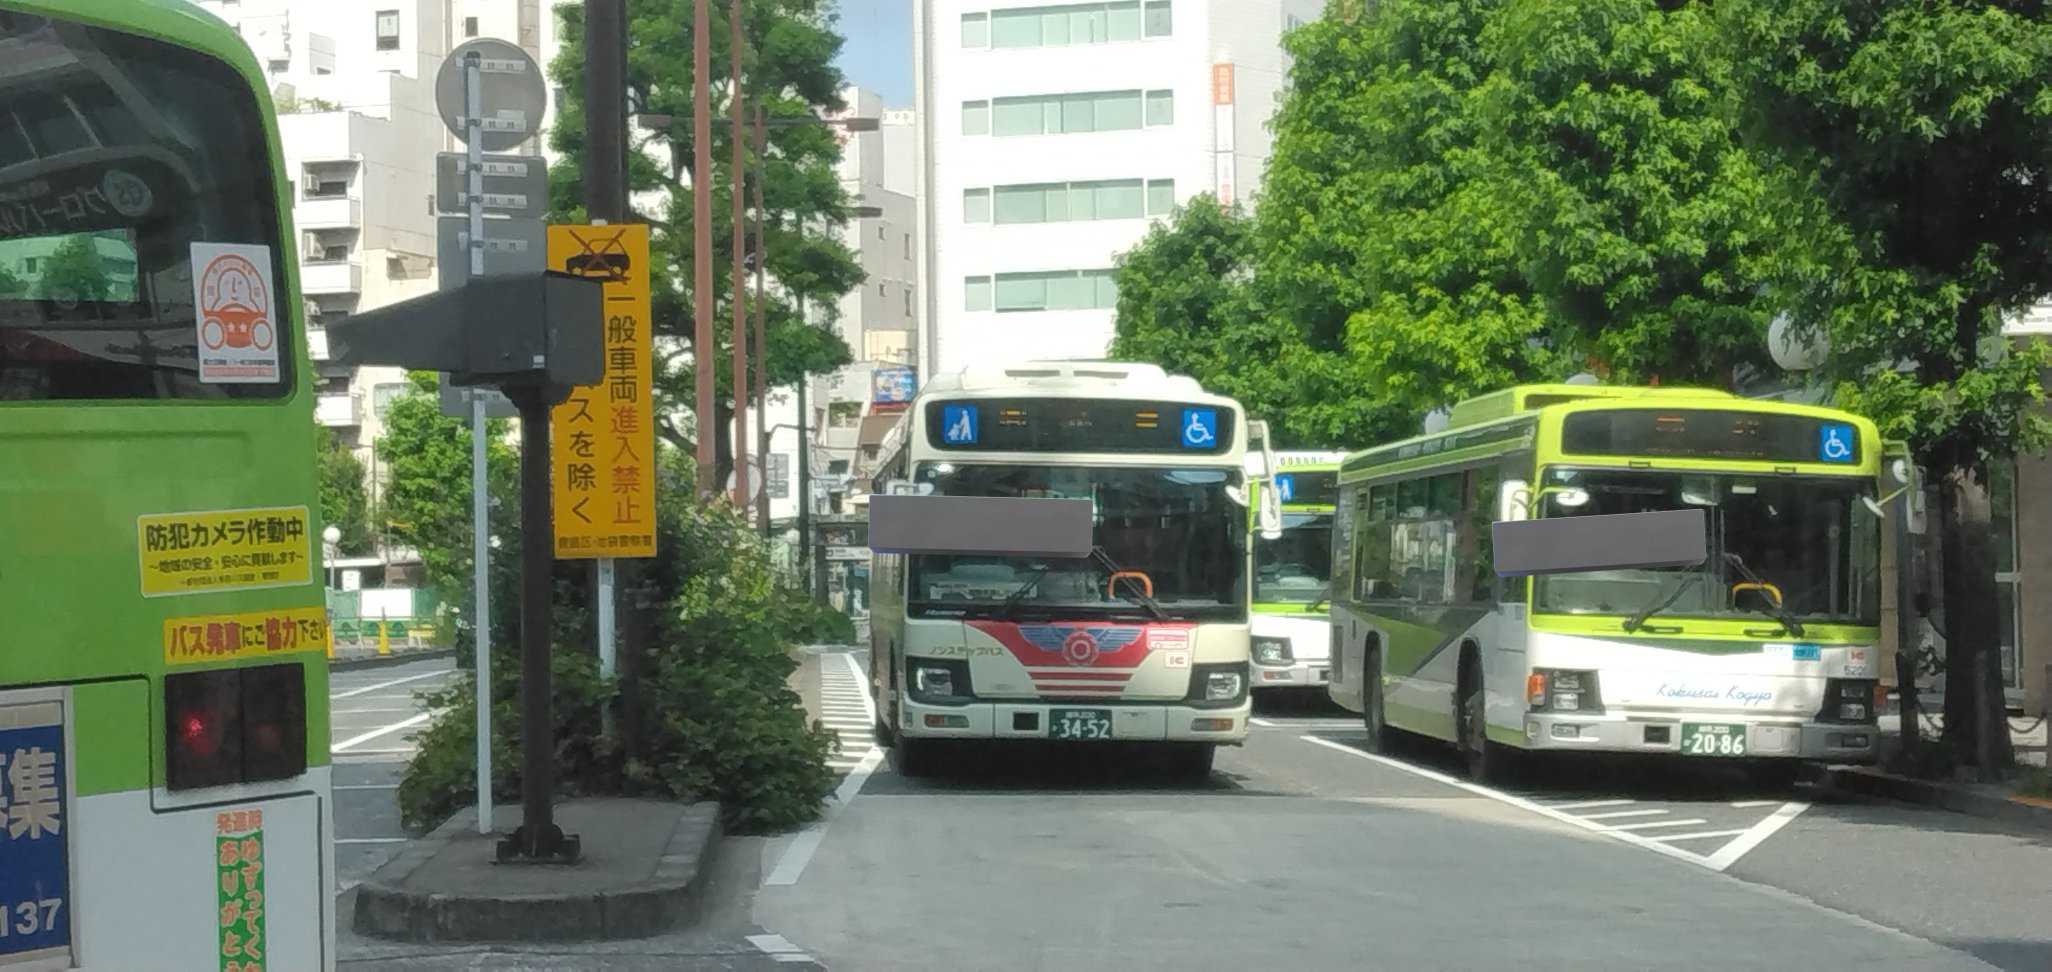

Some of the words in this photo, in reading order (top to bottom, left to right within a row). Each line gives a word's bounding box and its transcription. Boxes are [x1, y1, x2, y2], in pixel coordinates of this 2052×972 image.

[567, 383, 596, 524] スを除く
[608, 296, 641, 524] 一般車両進入禁止
[145, 515, 303, 552] 防犯カメラ作動中
[1060, 719, 1110, 739] 34-52
[0, 746, 61, 840] 集
